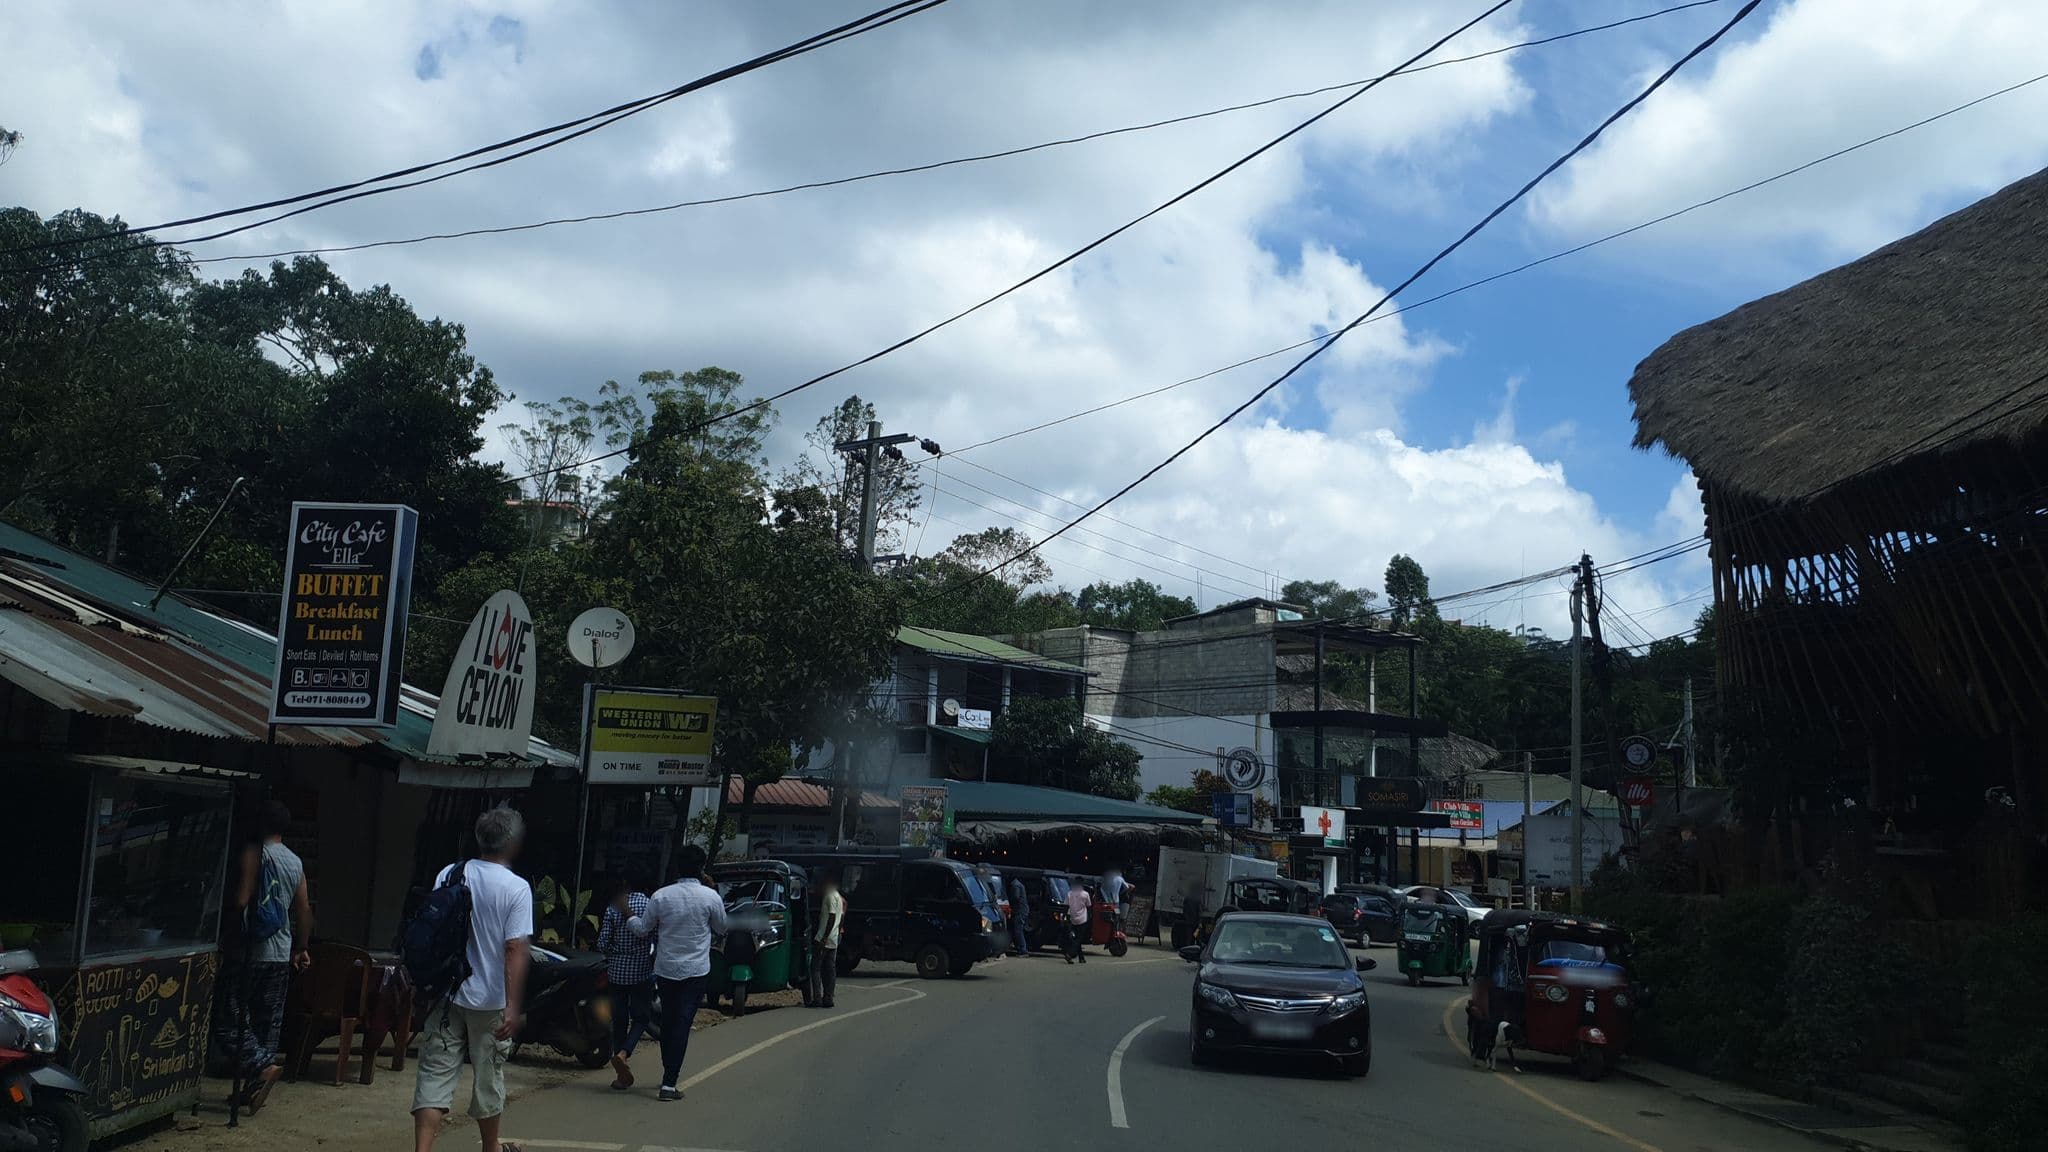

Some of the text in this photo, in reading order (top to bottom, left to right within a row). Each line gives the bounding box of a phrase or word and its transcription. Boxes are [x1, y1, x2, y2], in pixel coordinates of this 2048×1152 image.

[301, 520, 388, 555] City Cafe
[332, 547, 361, 564] Ella
[296, 573, 385, 597] BUFFET
[295, 601, 380, 620] Breakfast
[306, 623, 364, 641] Lunch
[473, 603, 532, 675] I LOVE
[583, 628, 620, 640] Dialog
[286, 649, 303, 661] Short
[304, 650, 317, 661] Eats
[457, 665, 524, 730] CEYLON
[602, 709, 662, 721] WESTERN
[620, 719, 661, 729] UNION
[603, 762, 641, 771] ON TIME
[1627, 783, 1649, 803] illy
